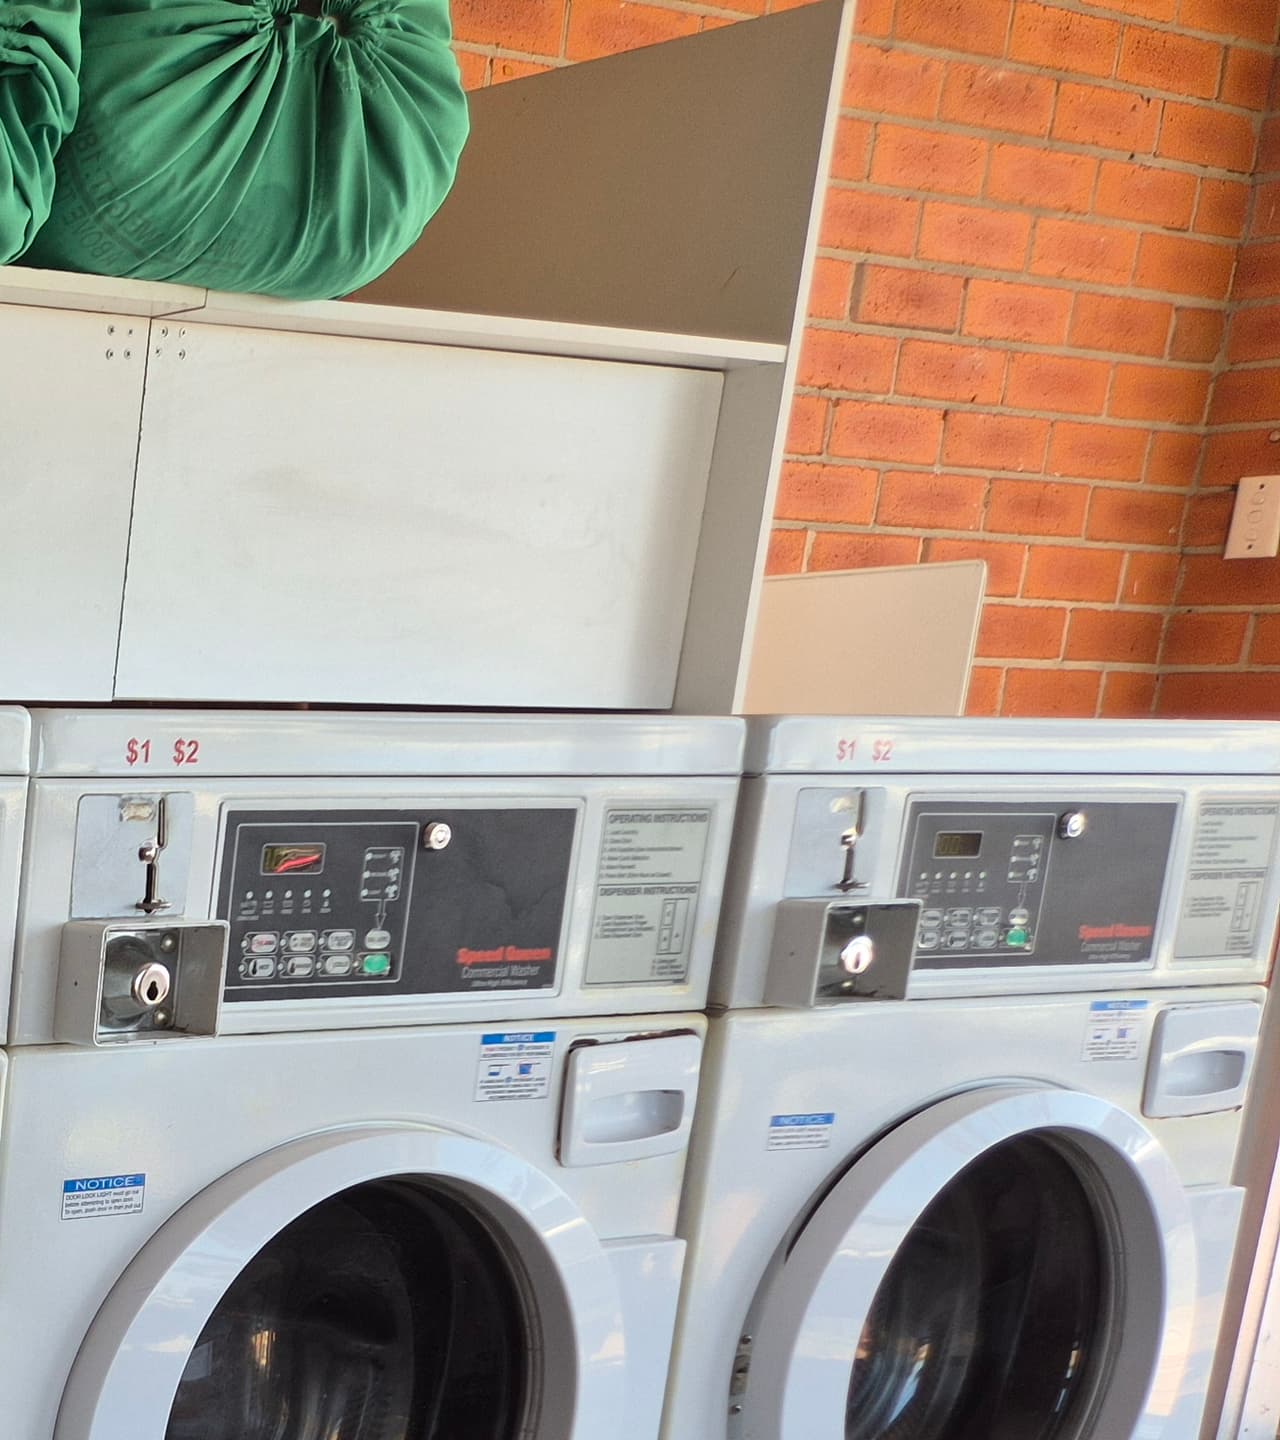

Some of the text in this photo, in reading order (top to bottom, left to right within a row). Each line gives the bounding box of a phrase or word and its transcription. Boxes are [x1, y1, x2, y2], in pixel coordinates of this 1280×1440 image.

[125, 737, 200, 765] $1 $2
[837, 739, 895, 763] $1 $2
[75, 1176, 135, 1191] NOTICE
